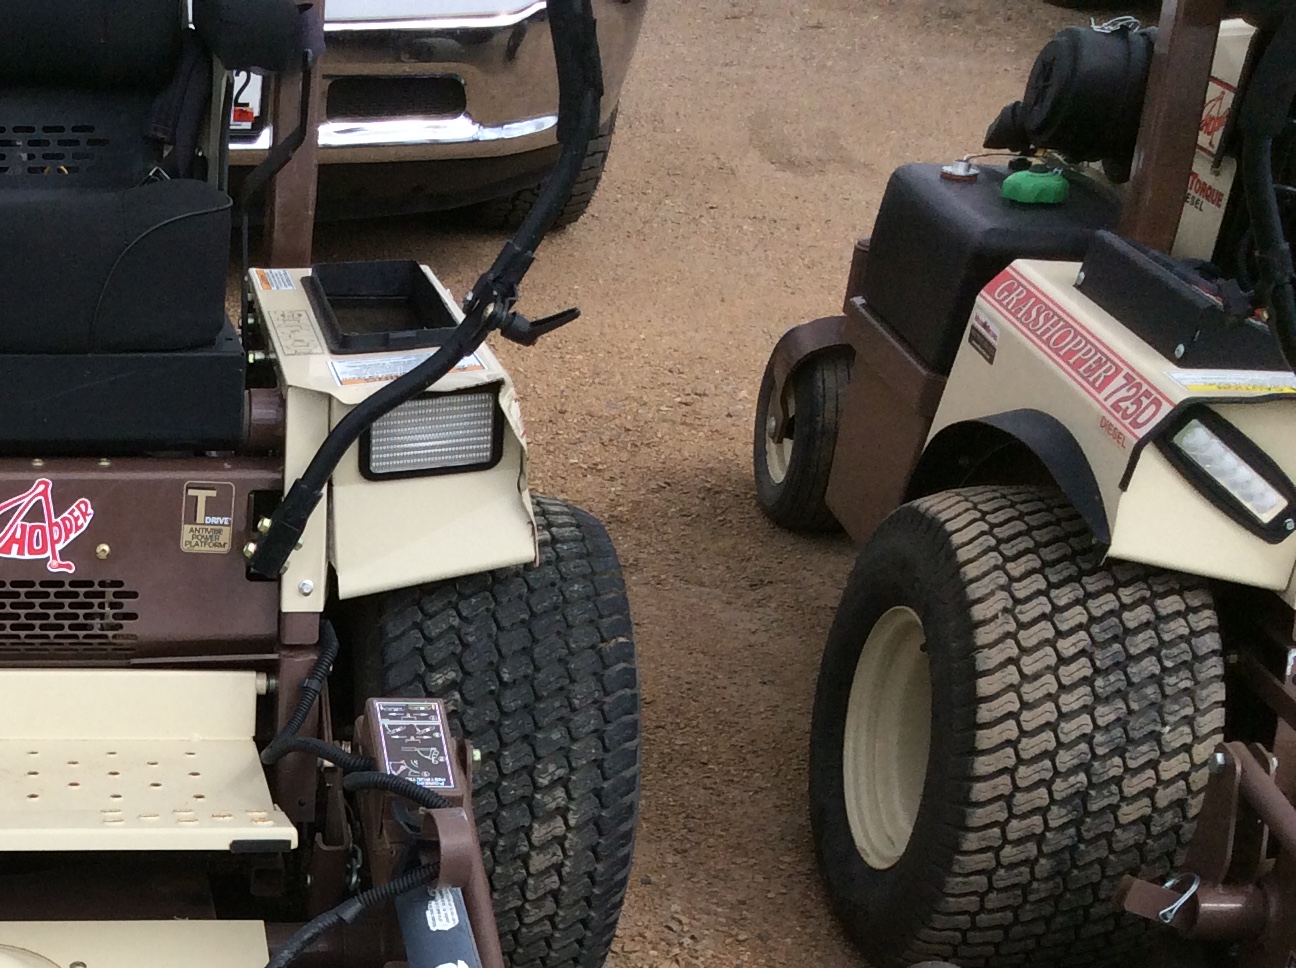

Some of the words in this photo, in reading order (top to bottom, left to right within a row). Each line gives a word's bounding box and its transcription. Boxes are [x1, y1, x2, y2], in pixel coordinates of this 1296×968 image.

[994, 279, 1117, 388] GRASSHOPPER
[1103, 372, 1163, 430] 725D
[1100, 416, 1127, 449] DIESEL
[187, 488, 217, 524] T
[205, 516, 231, 525] DRIVE
